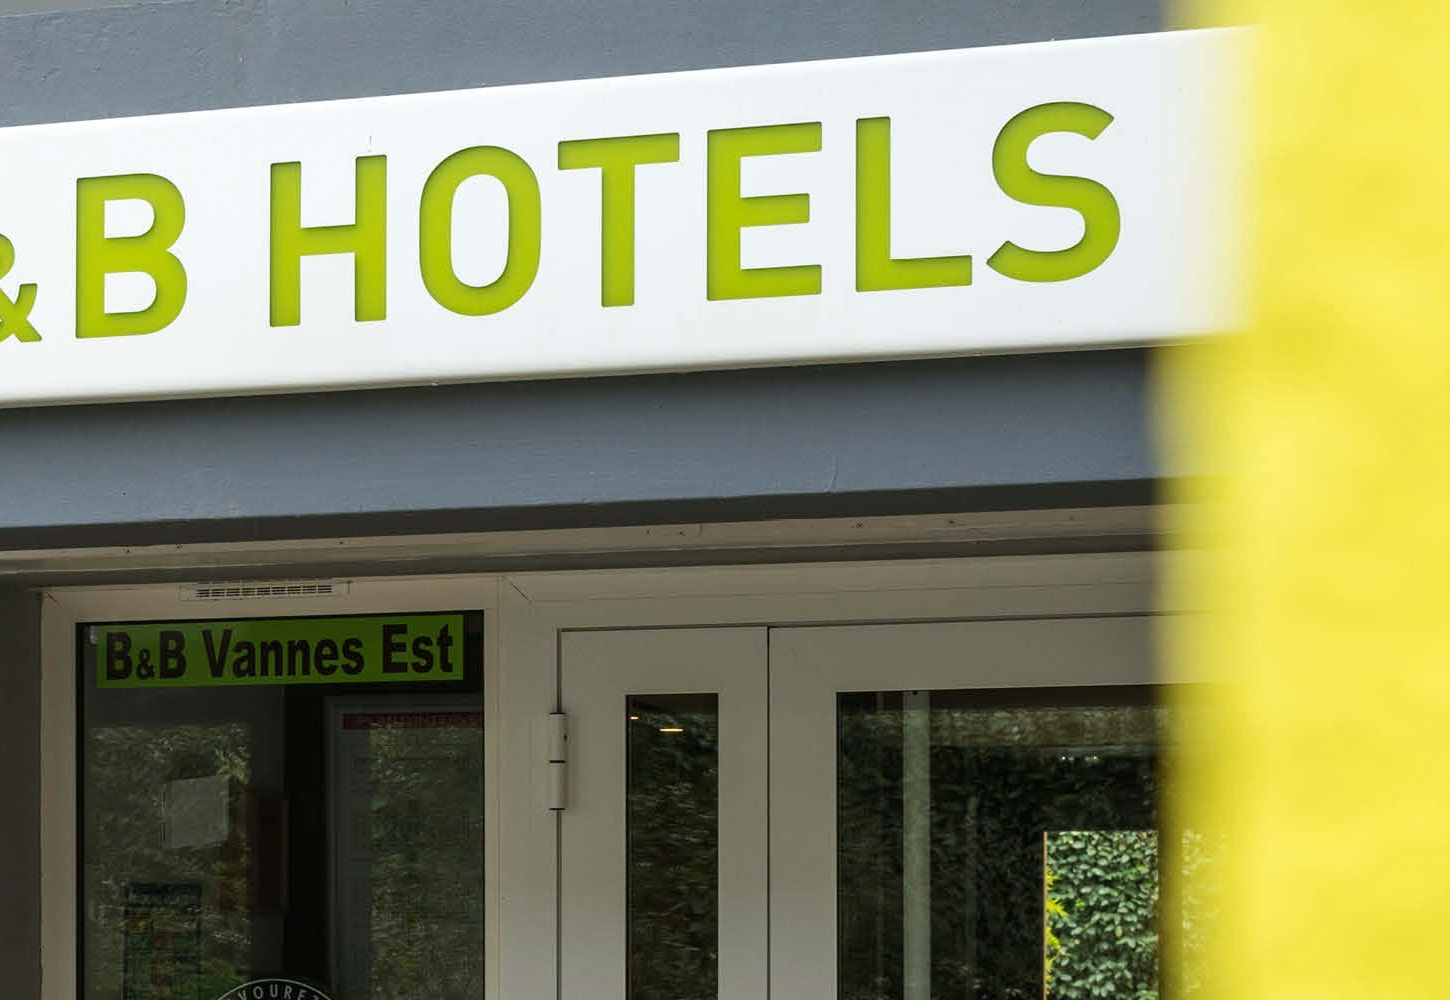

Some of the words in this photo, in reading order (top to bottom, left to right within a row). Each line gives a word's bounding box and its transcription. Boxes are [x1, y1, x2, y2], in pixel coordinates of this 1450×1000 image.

[270, 102, 1120, 326] HOTELS
[106, 630, 187, 681] B&B
[202, 628, 365, 678] Vannes
[382, 623, 453, 674] Est
